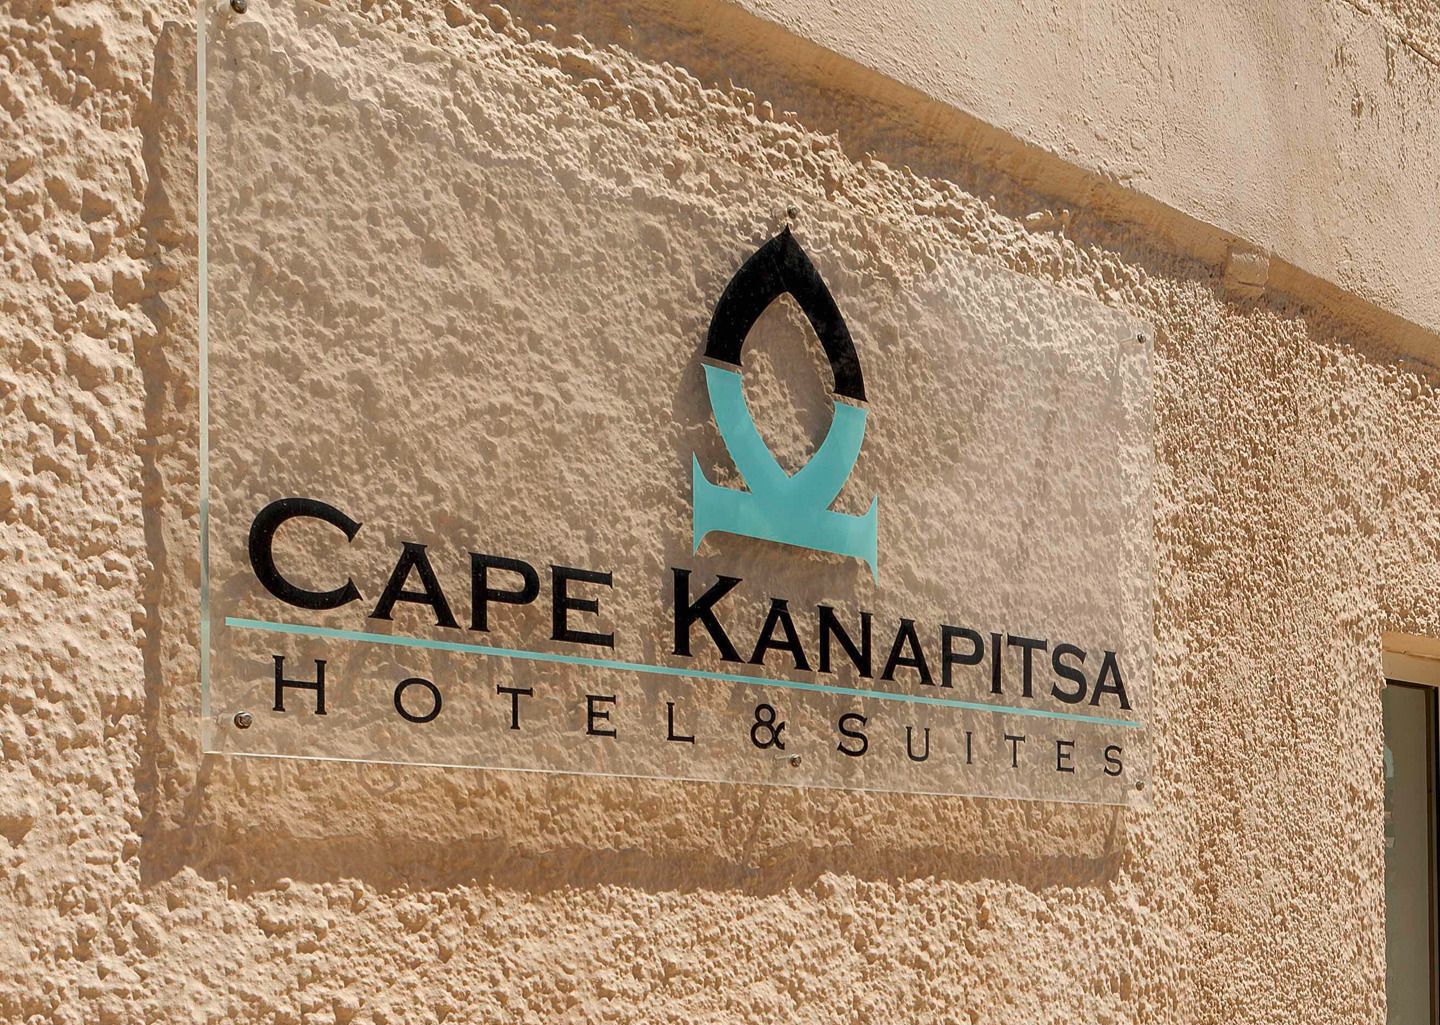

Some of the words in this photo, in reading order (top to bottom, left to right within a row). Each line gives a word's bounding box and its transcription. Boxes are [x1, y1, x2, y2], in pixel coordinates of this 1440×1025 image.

[248, 497, 615, 650] CAPE
[671, 567, 1132, 710] KANAPITSA
[272, 655, 695, 744] HOTEL
[750, 703, 785, 750] &
[837, 713, 1123, 776] SUITES
